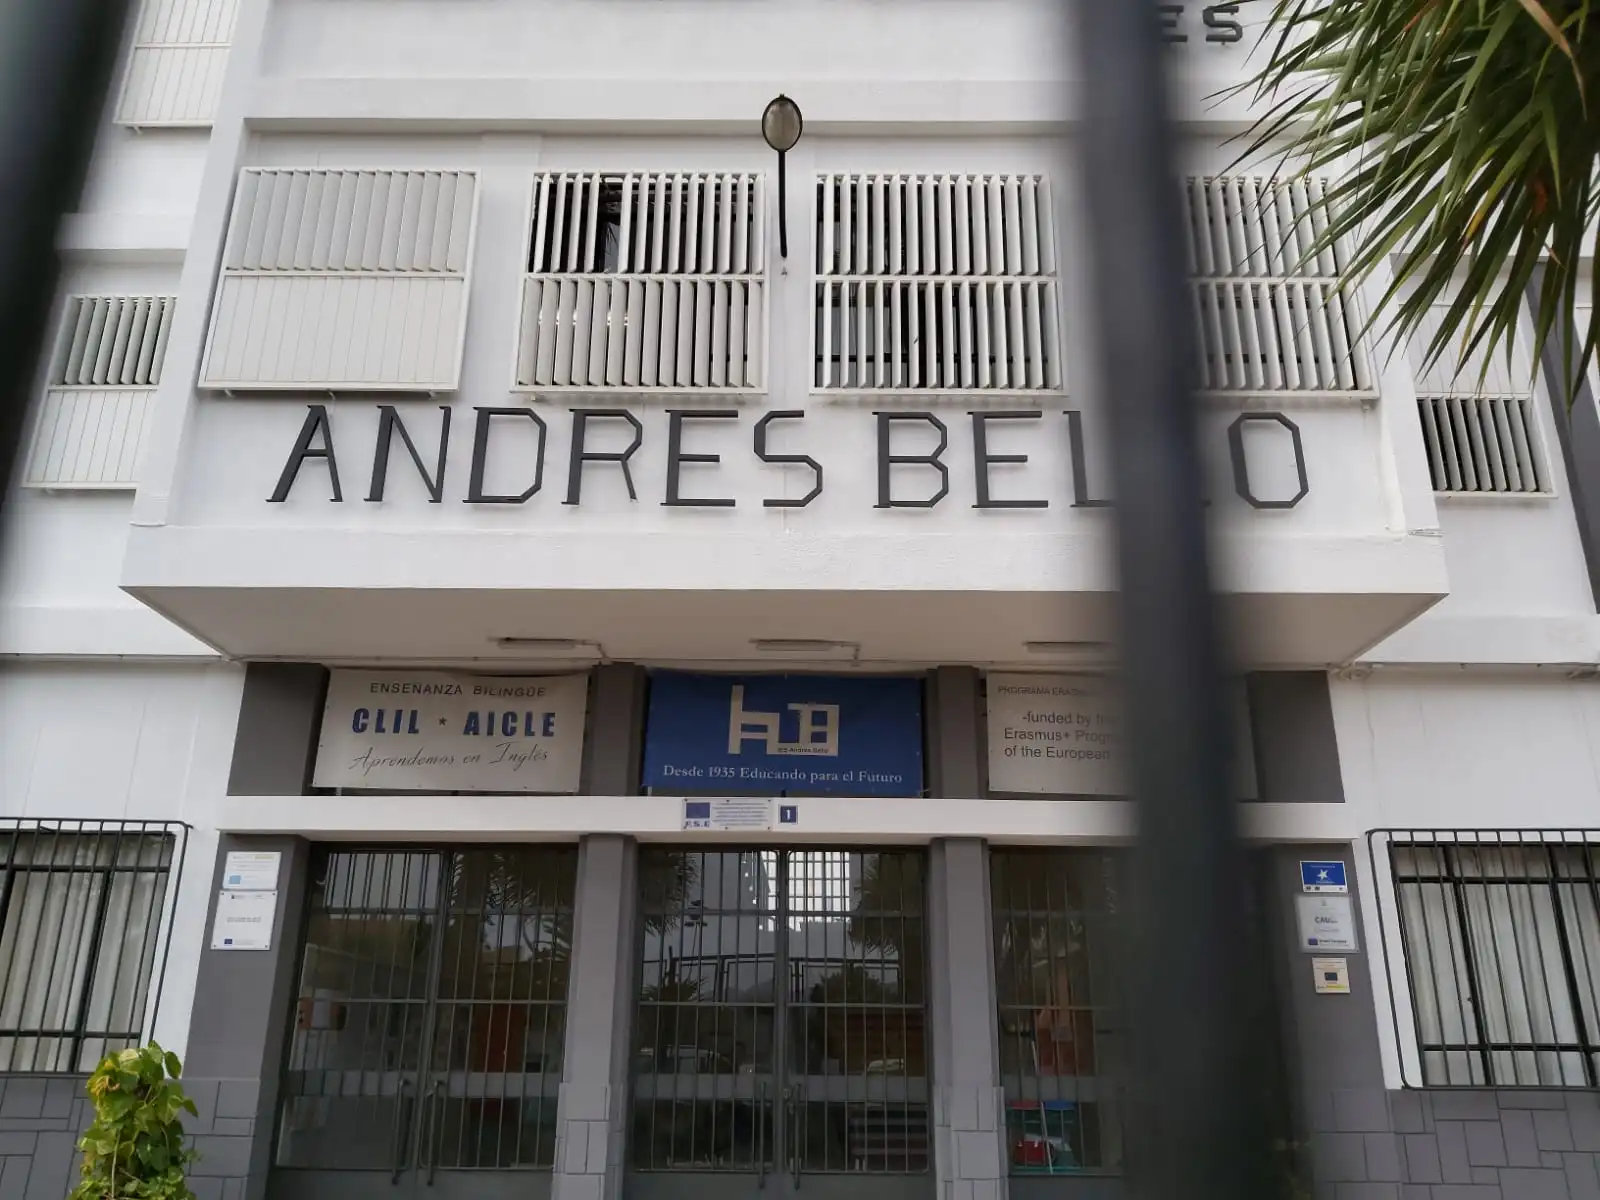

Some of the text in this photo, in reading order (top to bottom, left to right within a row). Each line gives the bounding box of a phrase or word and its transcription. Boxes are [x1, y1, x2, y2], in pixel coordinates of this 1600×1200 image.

[265, 404, 1309, 509] ANDRES BELO
[472, 684, 546, 698] BILINGÜE
[352, 707, 556, 738] CLIL AICLE
[1076, 713, 1092, 728] by
[1004, 727, 1113, 745] Erasmus+ Progr
[348, 746, 455, 777] Aprendemos
[463, 754, 480, 764] en
[1004, 745, 1111, 762] of the European
[663, 764, 903, 784] Desde 1935 Educando para el Futuro
